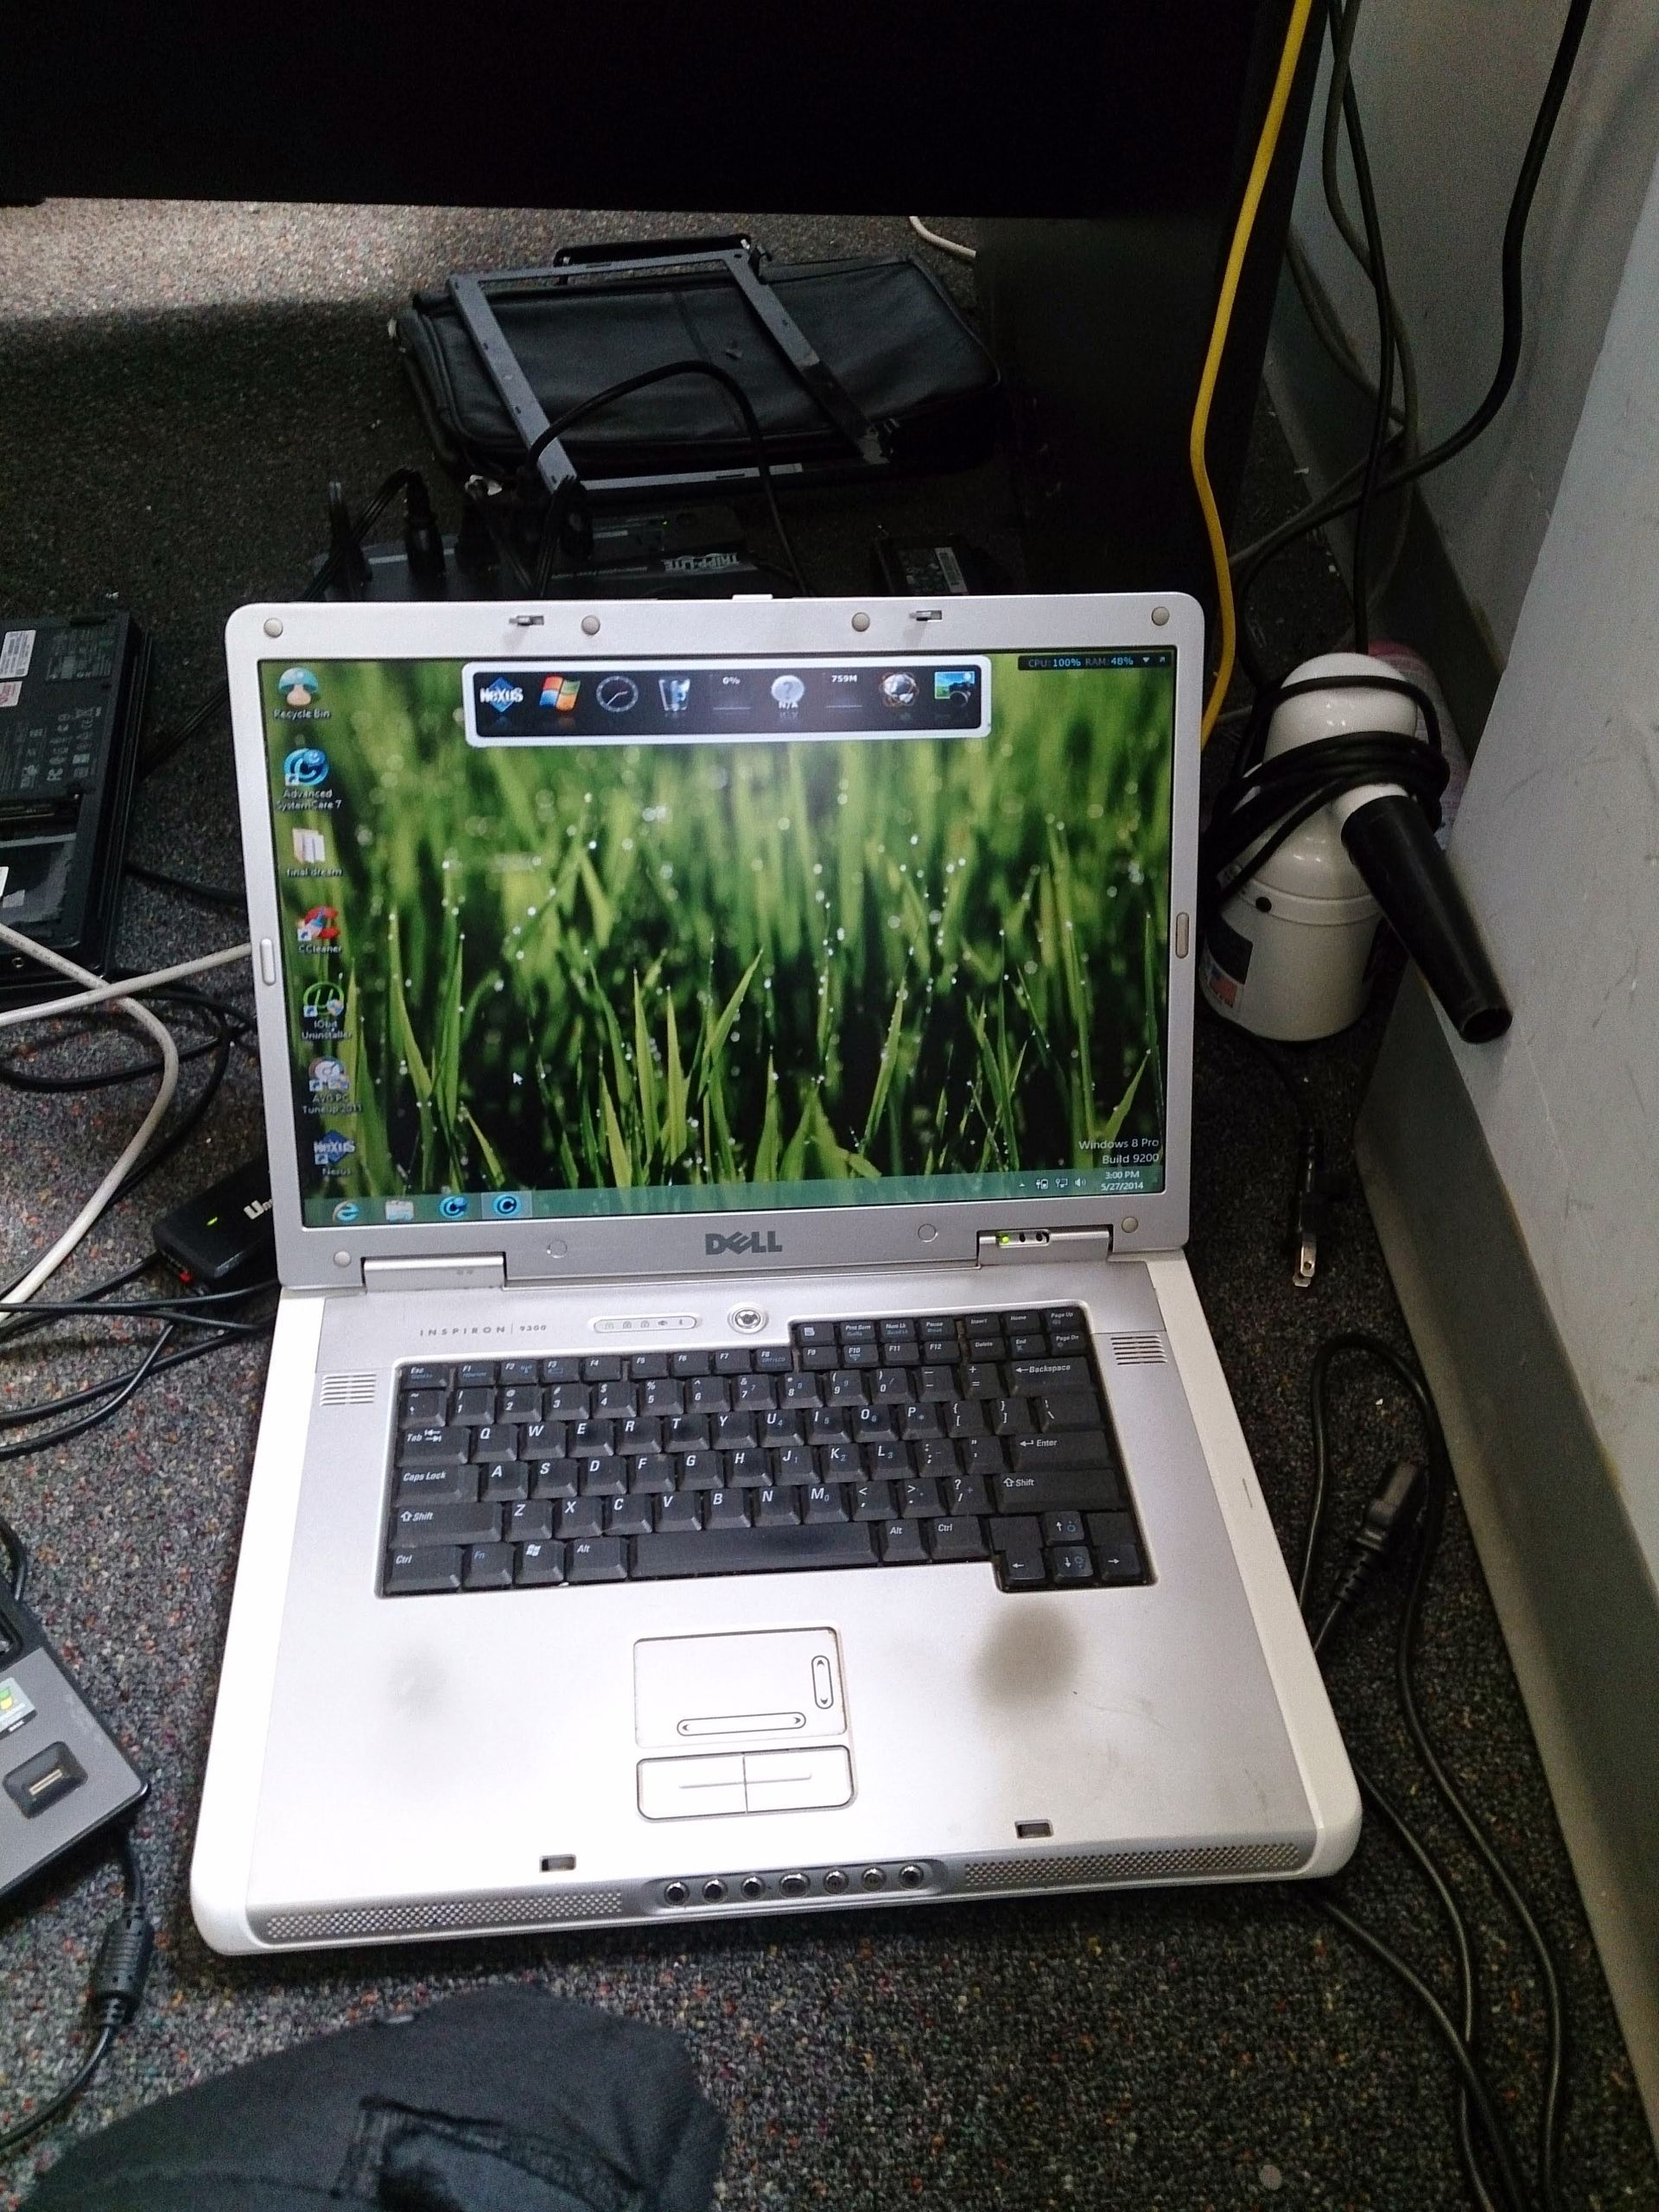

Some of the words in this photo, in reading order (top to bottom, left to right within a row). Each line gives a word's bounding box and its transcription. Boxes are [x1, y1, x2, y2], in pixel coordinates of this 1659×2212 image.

[1053, 658, 1081, 667] 100%
[1110, 657, 1134, 665] 48%
[831, 674, 858, 683] 759M
[274, 709, 311, 721] Recycle
[314, 709, 330, 718] Bin
[283, 789, 333, 798] Advanced
[335, 799, 342, 809] 7
[298, 944, 342, 954] CCleaner
[1079, 1140, 1128, 1150] Windows
[1131, 1139, 1139, 1147] 8
[1141, 1138, 1160, 1147] Pro
[1102, 1154, 1129, 1164] Build
[1133, 1153, 1160, 1163] 9200
[1105, 1172, 1122, 1180] 3:00
[1101, 1181, 1144, 1191] 5/27/2014
[705, 1230, 783, 1255] DELL
[420, 1325, 505, 1337] INSPIRON
[1029, 1364, 1071, 1374] Backspace
[553, 1399, 561, 1408] 3
[601, 1396, 607, 1406] 4
[647, 1395, 655, 1403] 5
[505, 1402, 513, 1411] 2
[861, 1409, 870, 1420] O
[908, 1408, 916, 1417] P
[672, 1418, 681, 1428] T
[719, 1416, 728, 1427] Y
[767, 1414, 777, 1424] U
[529, 1426, 543, 1437] W
[577, 1423, 587, 1434] E
[625, 1421, 635, 1432] R
[407, 1433, 422, 1442] Tab
[480, 1427, 491, 1440] Q
[1037, 1439, 1058, 1447] Enter
[783, 1451, 791, 1461] J
[831, 1448, 840, 1459] K
[878, 1446, 886, 1456] L
[638, 1458, 647, 1469] F
[686, 1455, 696, 1466] G
[734, 1452, 745, 1464] H
[540, 1463, 550, 1474] S
[590, 1460, 601, 1471] D
[404, 1472, 424, 1482] Caps
[426, 1471, 446, 1480] Lock
[492, 1465, 502, 1478] A
[1016, 1478, 1035, 1487] Shift
[713, 1493, 723, 1505] B
[762, 1491, 773, 1502] N
[810, 1488, 824, 1500] M
[565, 1501, 575, 1513] X
[613, 1498, 624, 1510] C
[664, 1496, 673, 1507] V
[515, 1504, 525, 1516] Z
[412, 1512, 433, 1522] Shift
[890, 1526, 903, 1535] Alt
[938, 1523, 953, 1532] Ctrl
[577, 1544, 590, 1554] Alt
[396, 1554, 412, 1565] Ctrl
